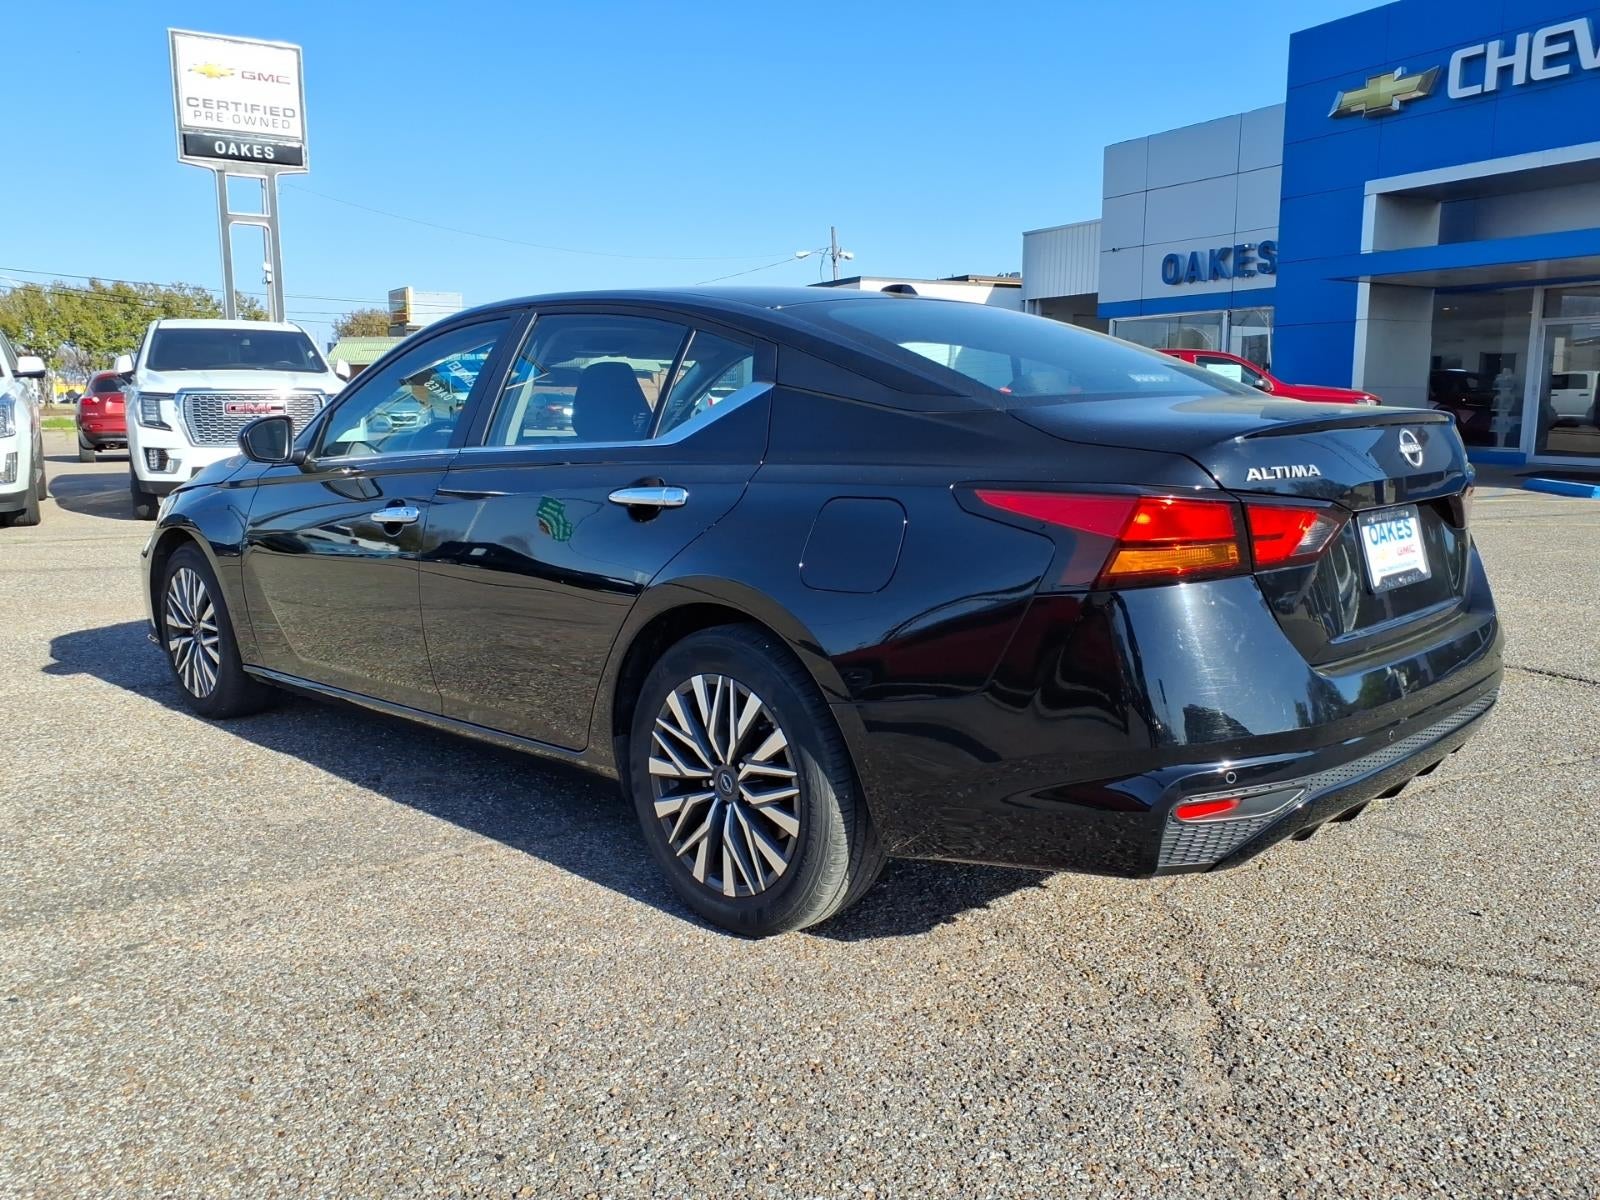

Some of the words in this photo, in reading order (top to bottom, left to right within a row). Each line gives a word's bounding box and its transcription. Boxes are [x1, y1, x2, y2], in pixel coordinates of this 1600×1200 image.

[1447, 17, 1600, 99] CHEV
[241, 70, 291, 85] GMC
[186, 96, 296, 118] CERTIFIED
[214, 140, 275, 159] OAKES
[1161, 240, 1278, 286] OAKES
[225, 401, 286, 415] GMC
[1246, 464, 1321, 482] ALTIMA
[1368, 518, 1413, 546] OAKES
